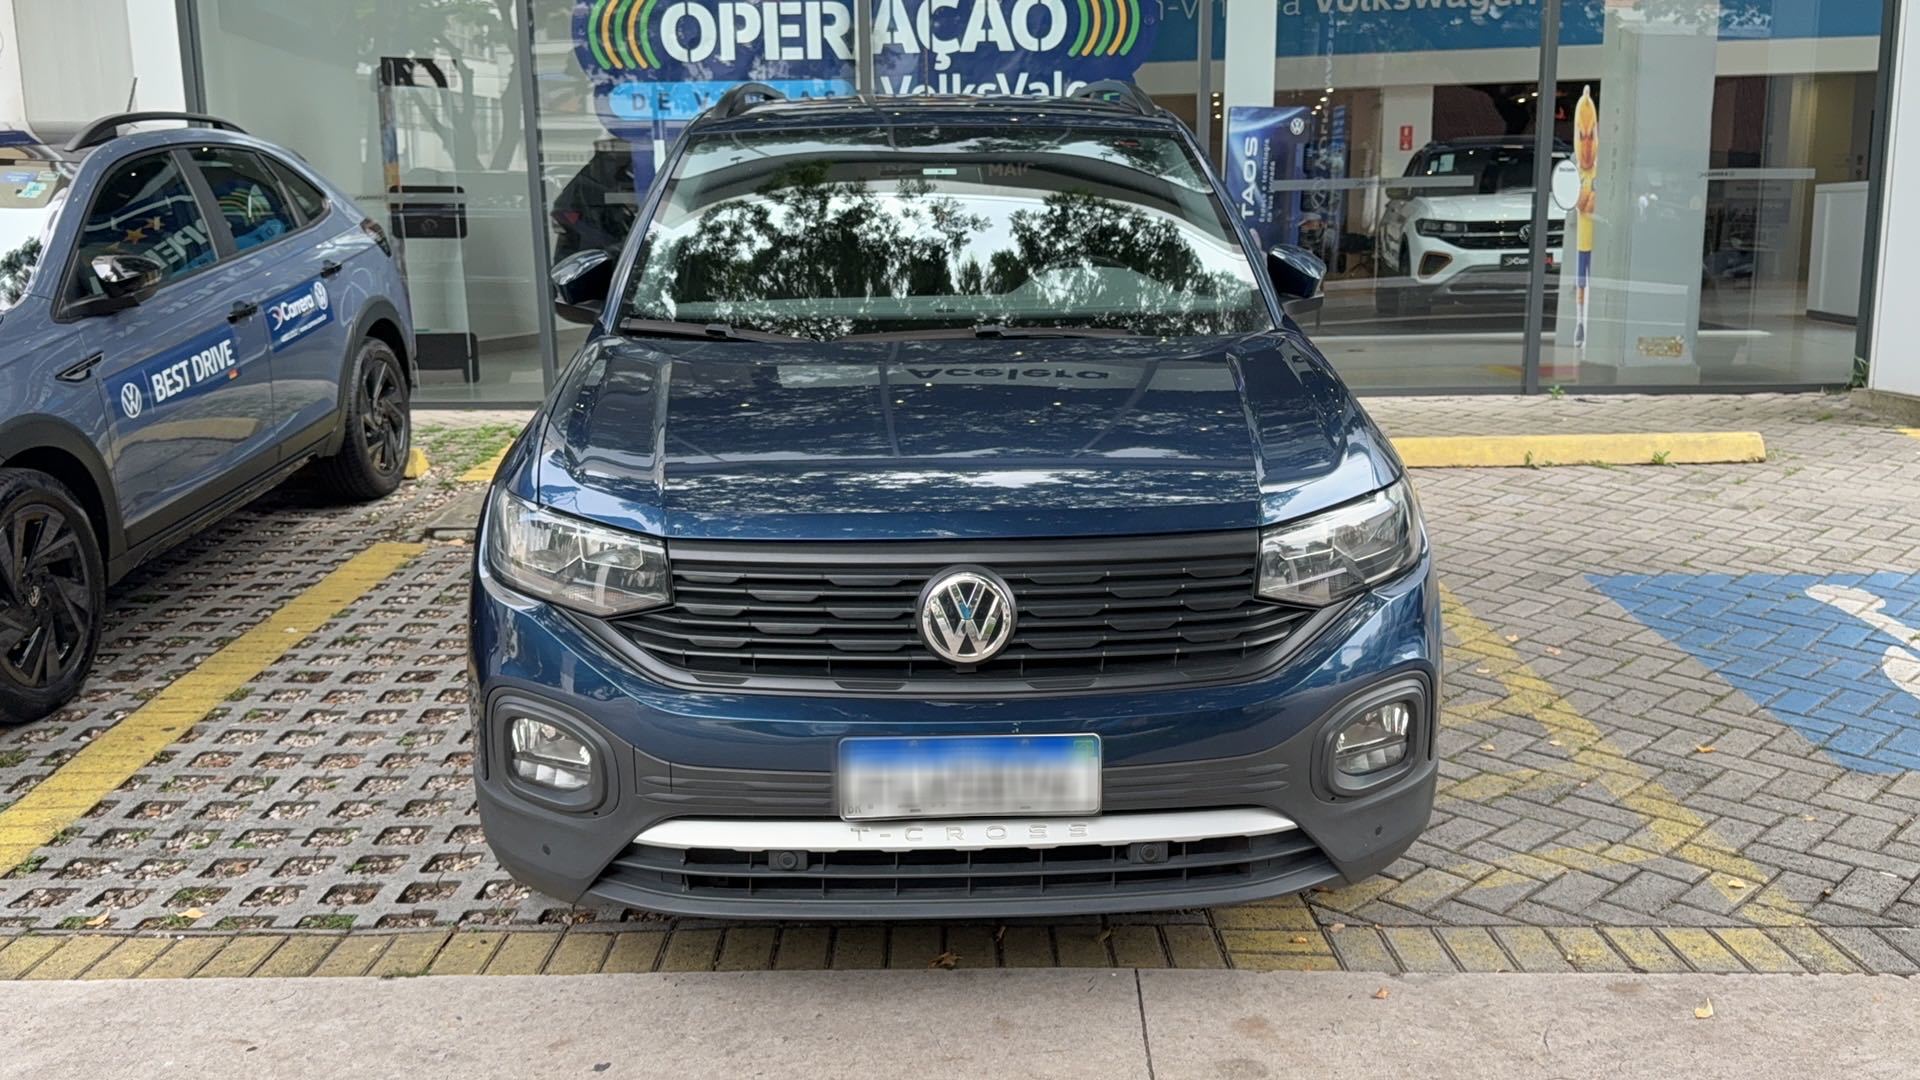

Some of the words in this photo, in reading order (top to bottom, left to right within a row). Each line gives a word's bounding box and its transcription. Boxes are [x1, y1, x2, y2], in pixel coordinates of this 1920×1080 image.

[1241, 136, 1259, 220] TAOS
[151, 360, 191, 403] BEST
[190, 339, 236, 383] DRIVE
[849, 822, 1091, 842] T-CROSS
